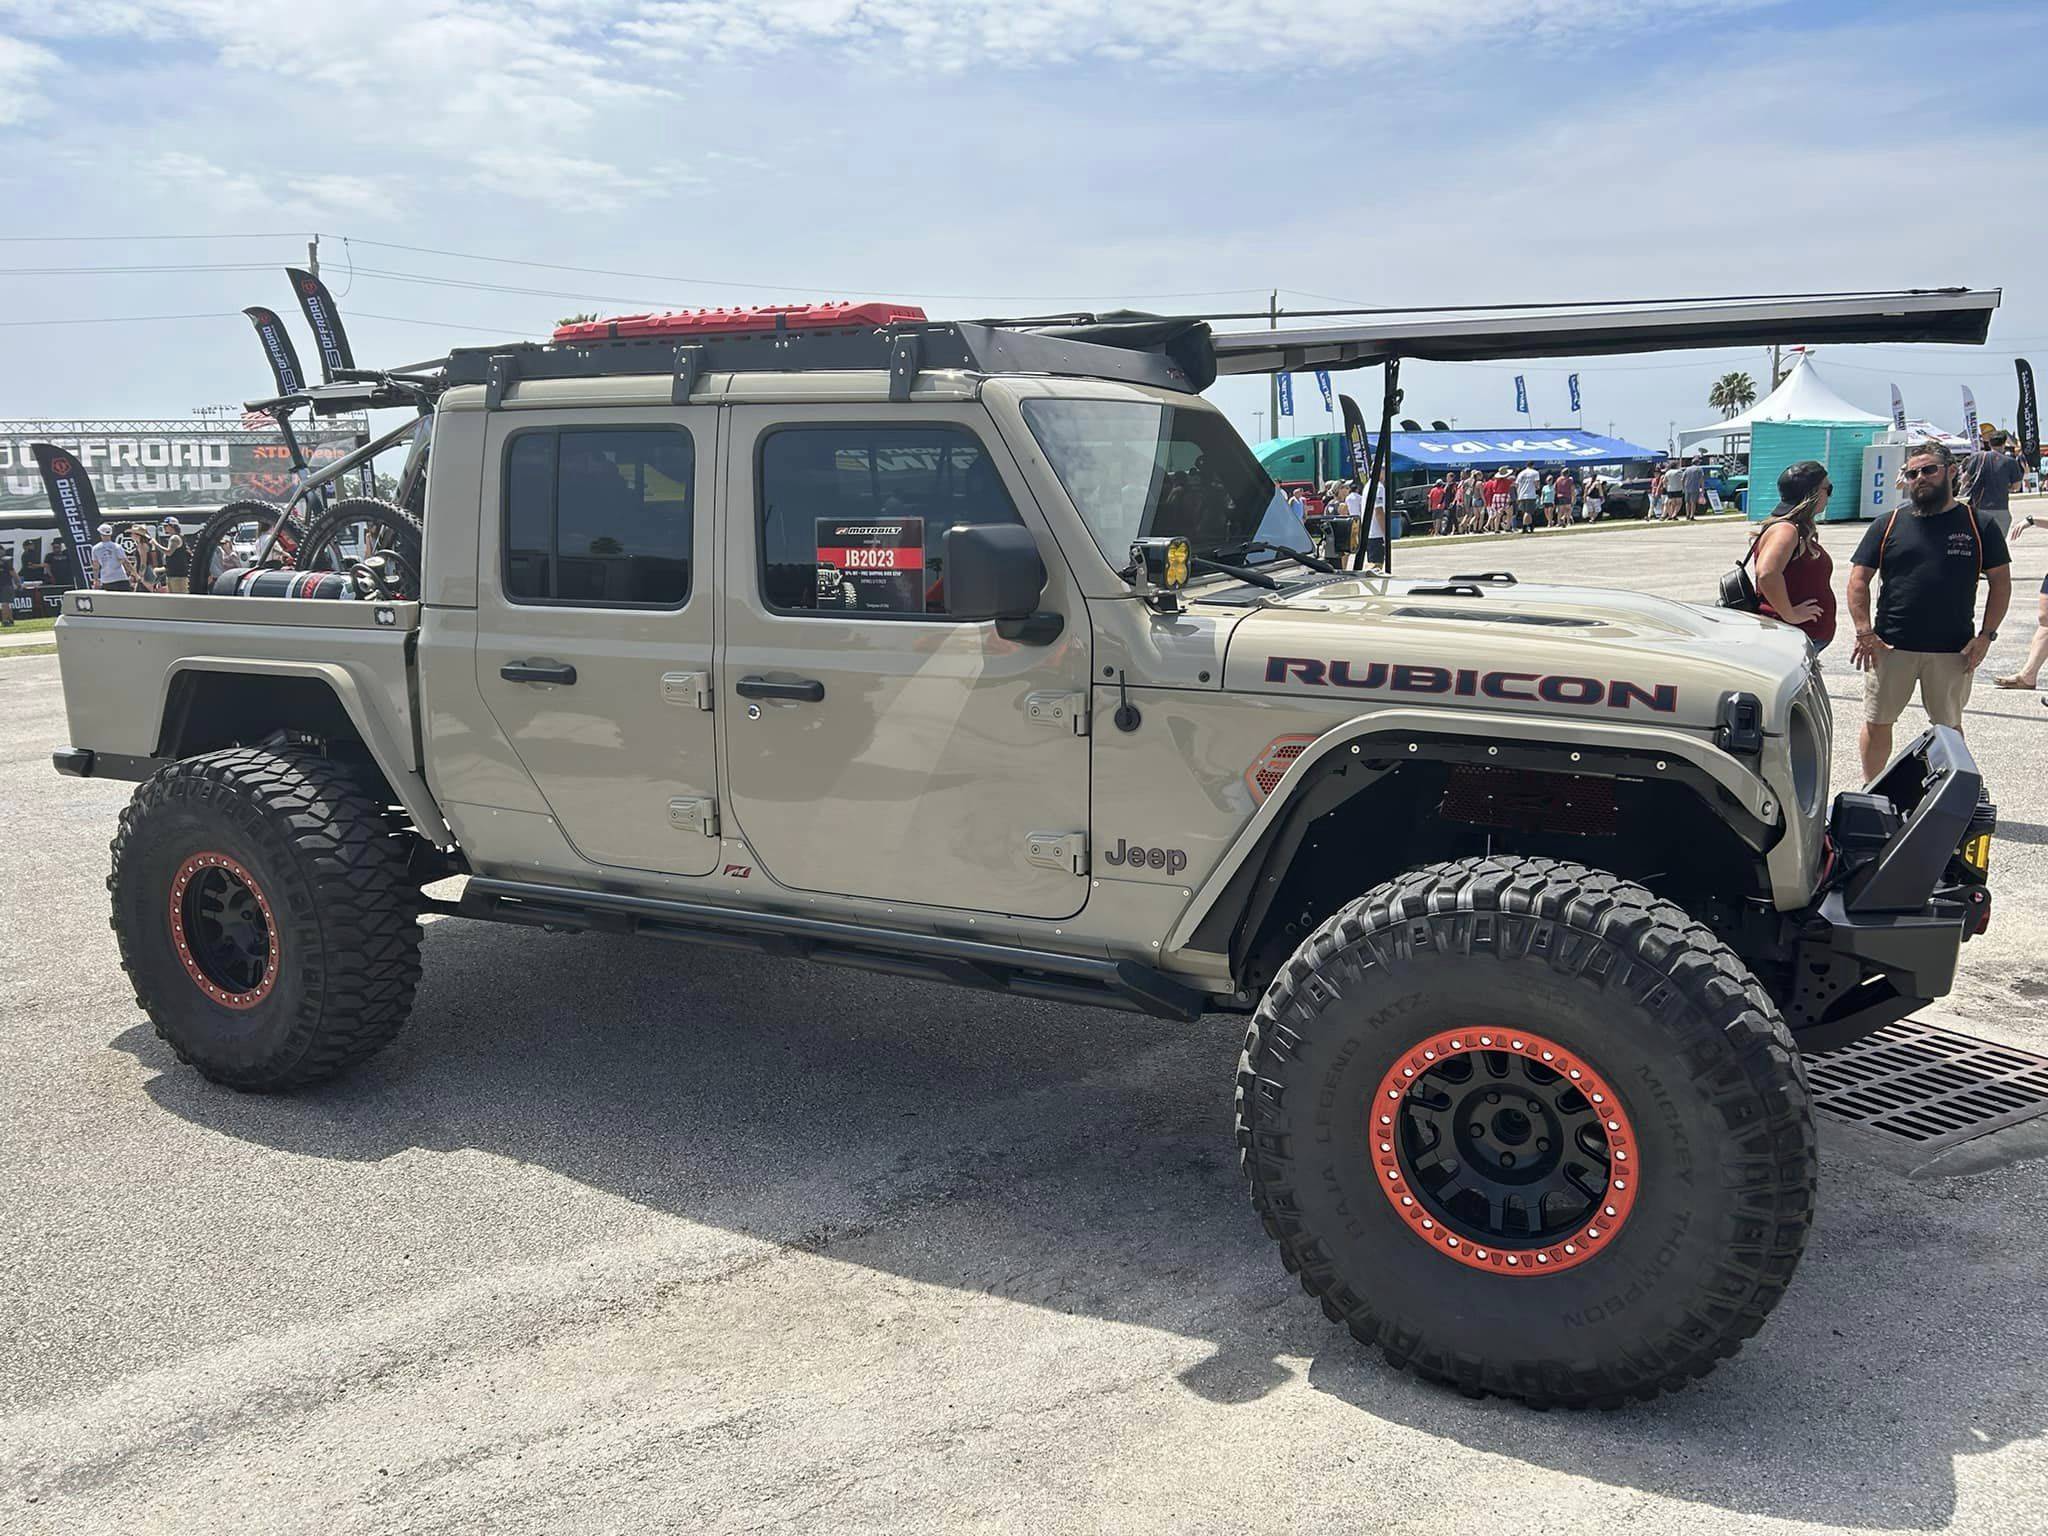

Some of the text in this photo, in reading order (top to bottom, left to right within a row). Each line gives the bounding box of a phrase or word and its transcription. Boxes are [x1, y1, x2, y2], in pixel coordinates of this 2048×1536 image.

[262, 325, 287, 369] OFFROAD
[307, 297, 332, 348] OFFROAD
[57, 478, 86, 543] OFFROAD
[848, 527, 902, 535] MOTOBILT
[844, 549, 895, 567] JB2023
[1264, 656, 1679, 713] RUBICON
[1105, 838, 1187, 876] Jeep
[1316, 1038, 1361, 1145] LEGEND
[1632, 1063, 1695, 1188] MICKEY
